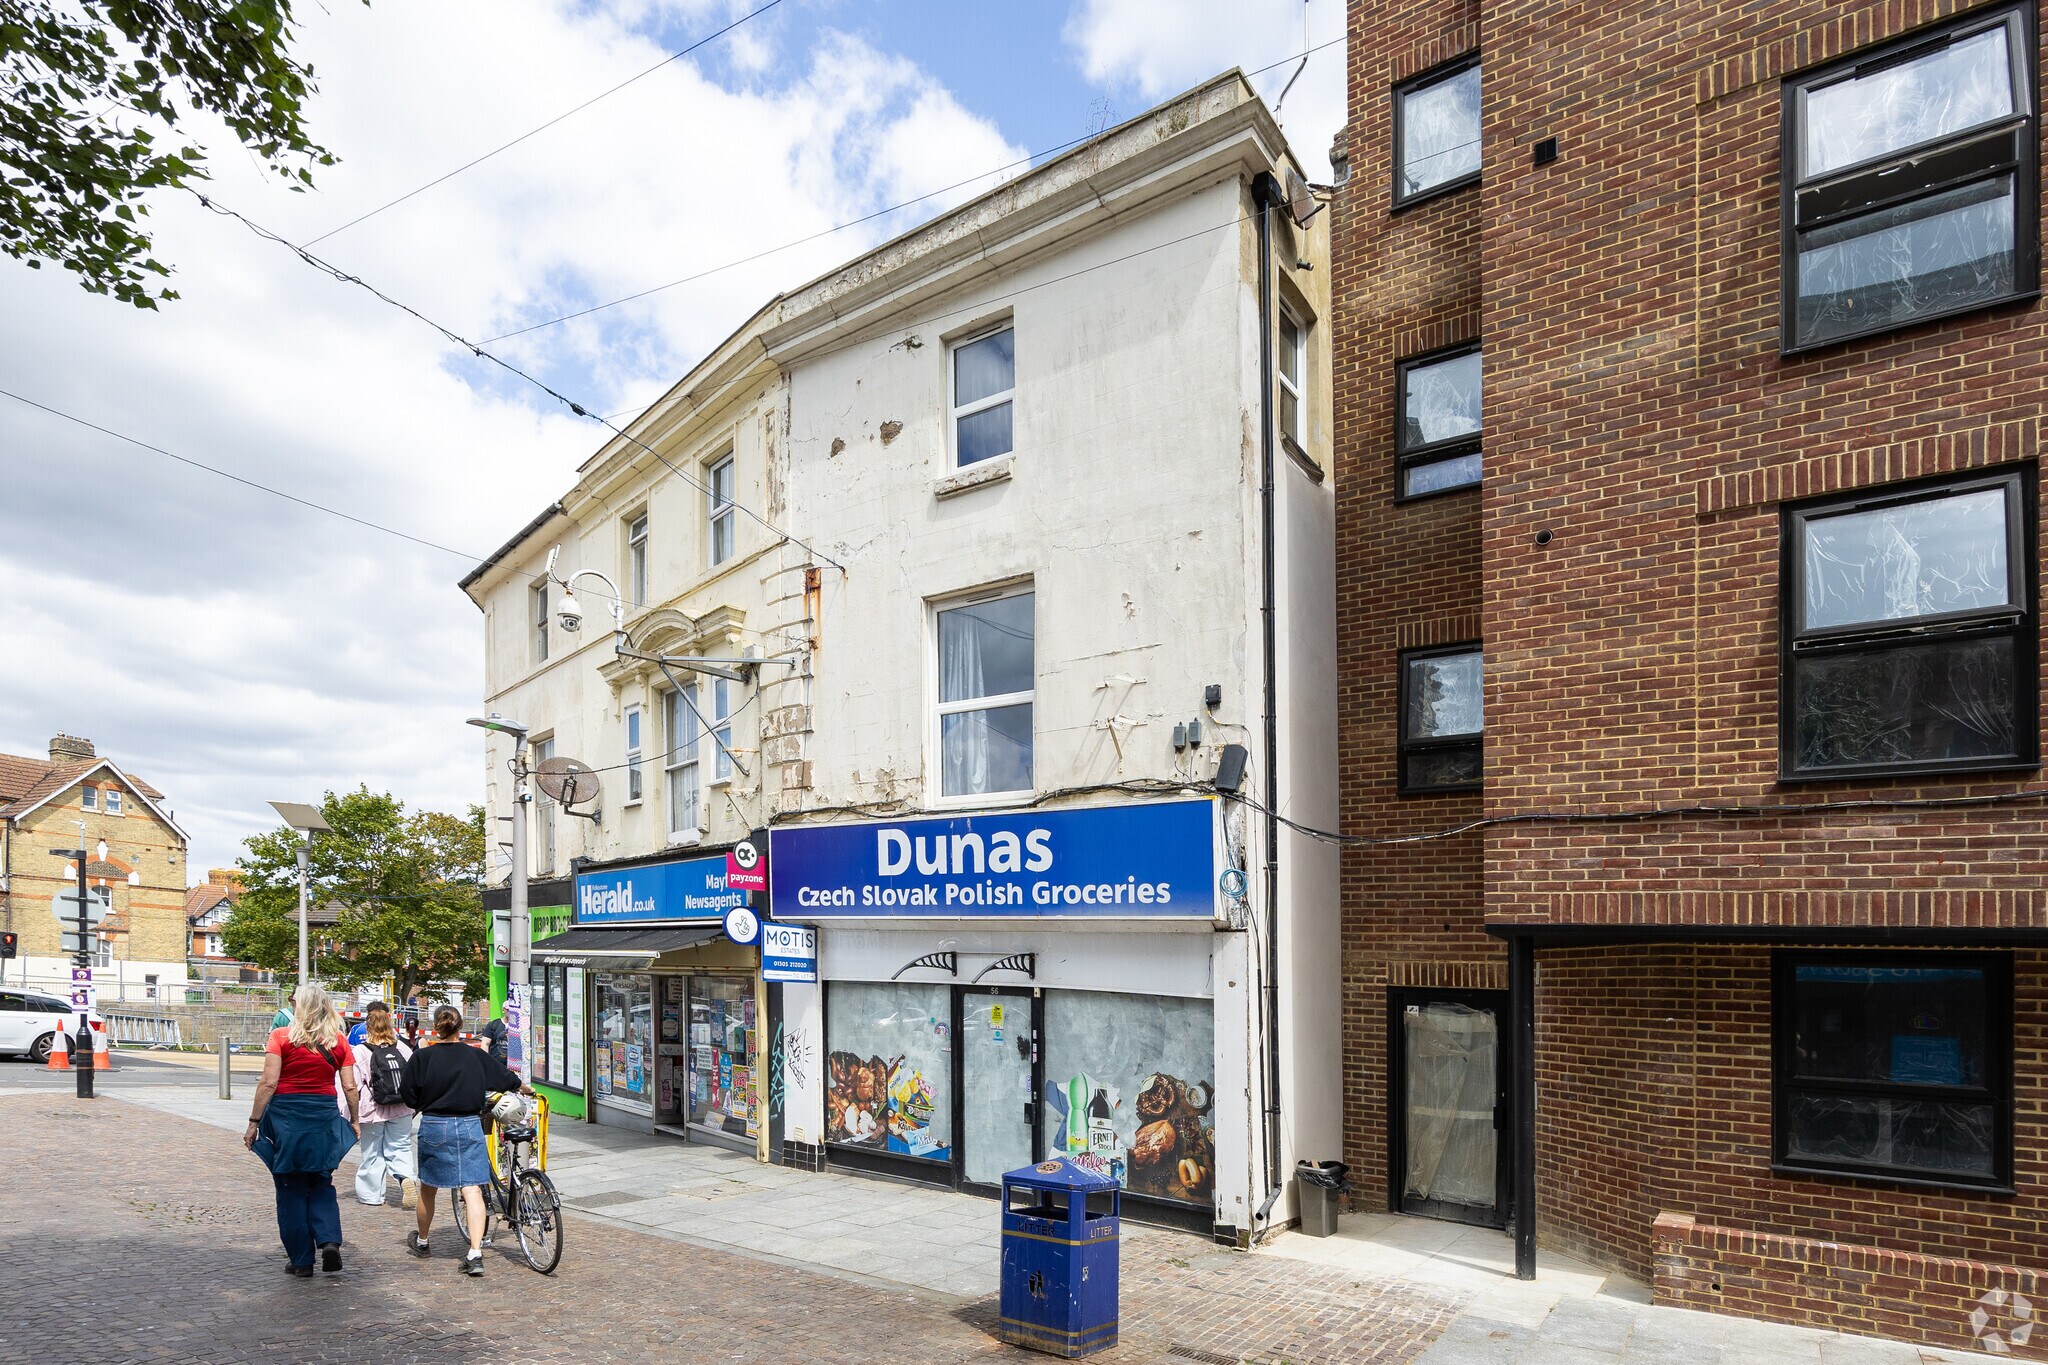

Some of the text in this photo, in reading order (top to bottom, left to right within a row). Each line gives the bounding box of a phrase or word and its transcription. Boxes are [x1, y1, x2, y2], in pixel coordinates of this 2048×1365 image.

[877, 828, 1053, 877] Dunas
[730, 873, 764, 884] payzone
[798, 875, 1171, 907] Czech Slovak Polish Groceries
[685, 894, 742, 912] Newsagents
[766, 930, 813, 948] MOTIS
[990, 987, 999, 995] 56
[1017, 1222, 1055, 1237] LITTER
[1090, 1225, 1112, 1239] LITTER
